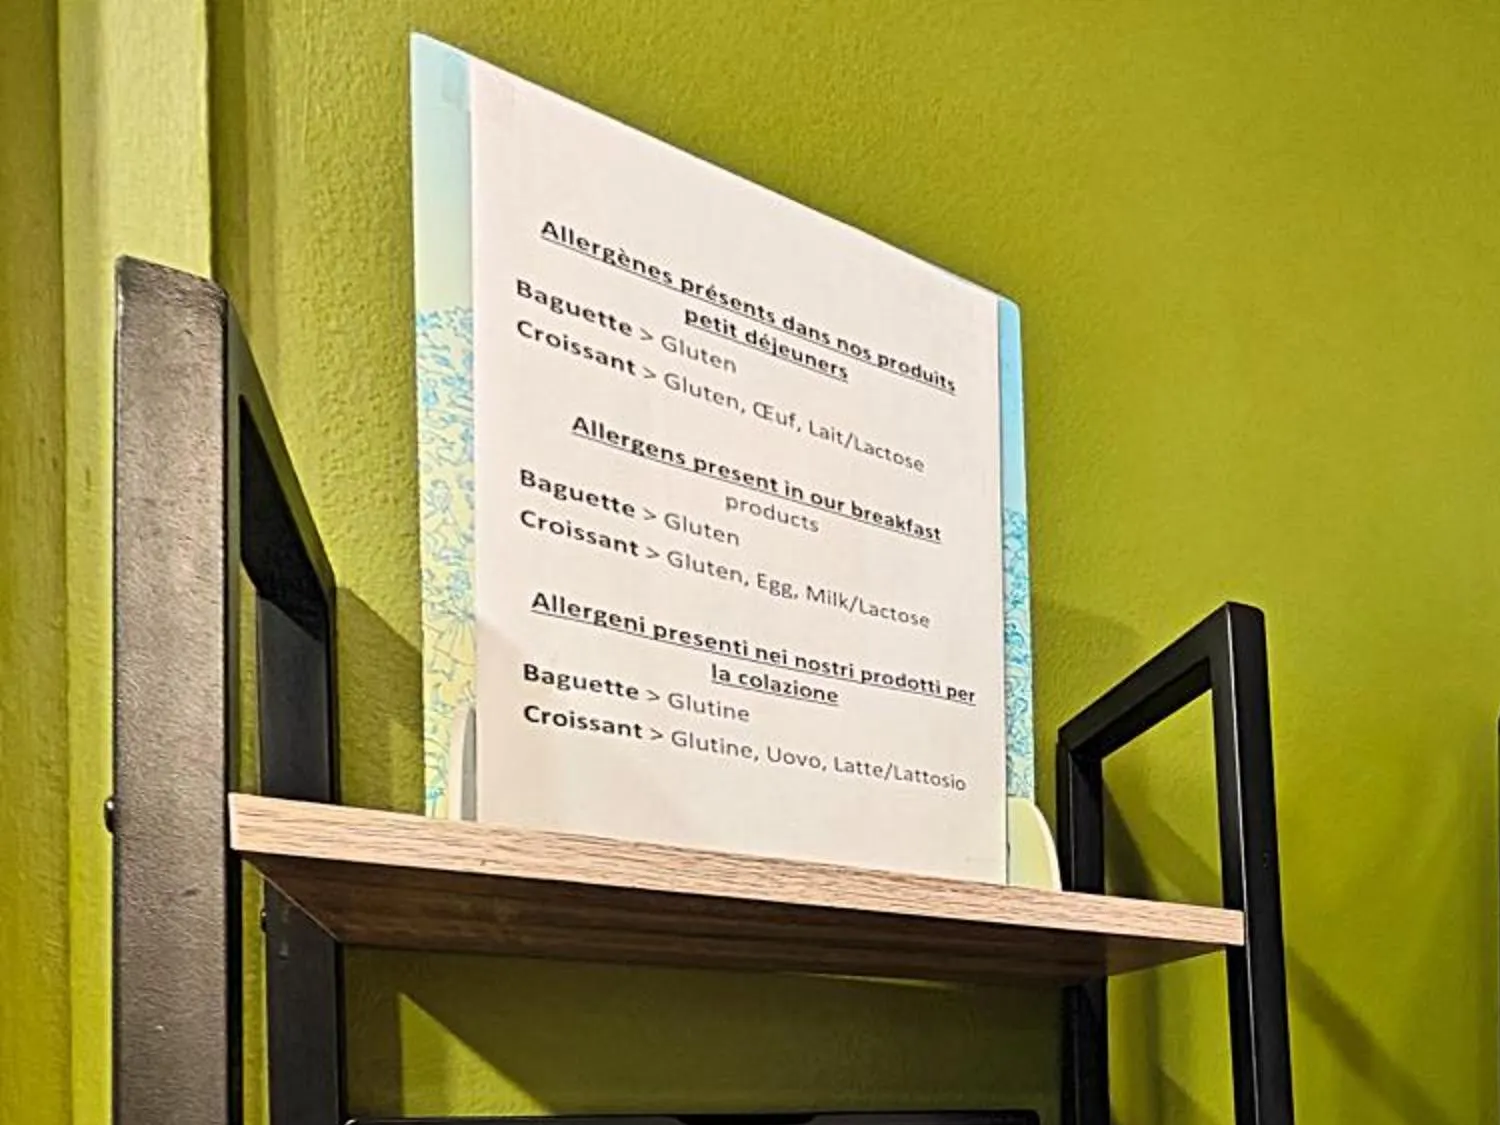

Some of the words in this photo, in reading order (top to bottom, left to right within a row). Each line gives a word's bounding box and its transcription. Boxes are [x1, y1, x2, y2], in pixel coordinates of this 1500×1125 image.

[516, 279, 633, 336] Baguette
[661, 334, 737, 374] Gluten
[541, 220, 673, 286] Allergènes
[680, 278, 776, 325] présents
[782, 315, 831, 346] dans
[836, 337, 872, 362] nos
[877, 352, 956, 392] produits
[684, 306, 738, 340] petit
[744, 324, 849, 380] déjeuners
[516, 320, 636, 376] Croissant
[664, 373, 746, 414] Gluten,
[753, 402, 802, 432] Œuf,
[808, 419, 926, 473] Lait/Lactose
[519, 469, 636, 518] Baguette
[664, 513, 740, 547] Gluten
[572, 416, 686, 466] Allergens
[693, 456, 779, 494] present
[784, 479, 804, 501] in
[810, 488, 845, 510] our
[851, 499, 942, 542] breakfast
[725, 494, 819, 534] products
[520, 509, 639, 557] Croissant
[667, 551, 749, 588] Gluten,
[806, 585, 931, 629] Milk/Lactose
[522, 663, 639, 701] Baguette
[668, 692, 750, 723] Glutine
[531, 591, 646, 634] Allergeni
[653, 623, 749, 658] presenti
[755, 645, 788, 666] nei
[795, 653, 854, 680] nostri
[860, 666, 941, 696] prodotti
[947, 684, 976, 704] per
[711, 663, 731, 684] la
[738, 670, 840, 703] colazione
[523, 704, 643, 740] Croissant
[671, 730, 760, 764] Glutine,
[767, 745, 828, 773] Uovo,
[834, 755, 967, 792] Latte/Lattosio
